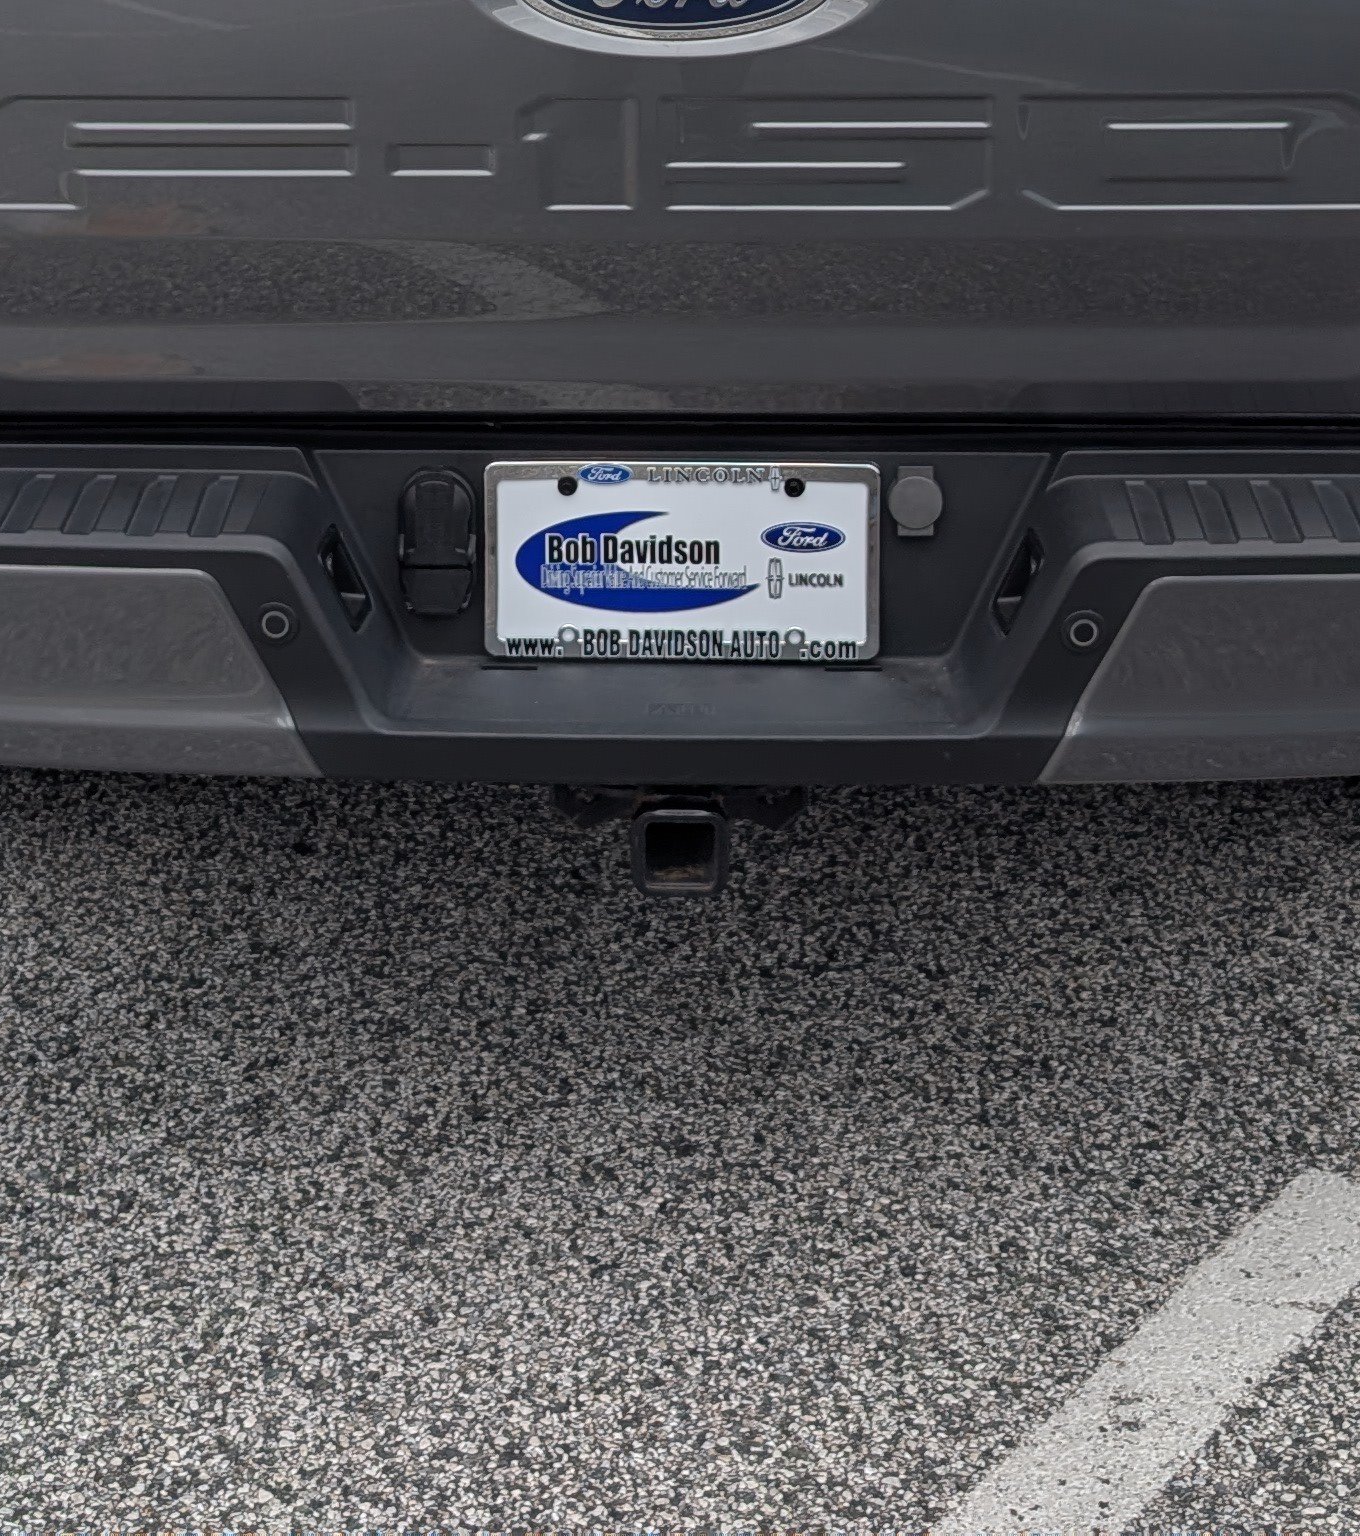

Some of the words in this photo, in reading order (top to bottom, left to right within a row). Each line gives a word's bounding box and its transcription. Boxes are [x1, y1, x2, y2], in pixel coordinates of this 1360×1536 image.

[587, 467, 623, 482] Ford
[647, 466, 766, 484] LINCOLN
[776, 525, 831, 549] Ford
[545, 533, 600, 565] Bob
[602, 533, 721, 566] Davidson
[787, 572, 844, 588] LINCOLN
[505, 636, 564, 657] www.
[582, 628, 621, 657] BOB
[627, 628, 724, 659] DAVIDSON
[729, 629, 781, 659] AUTO
[799, 638, 858, 659] .com
